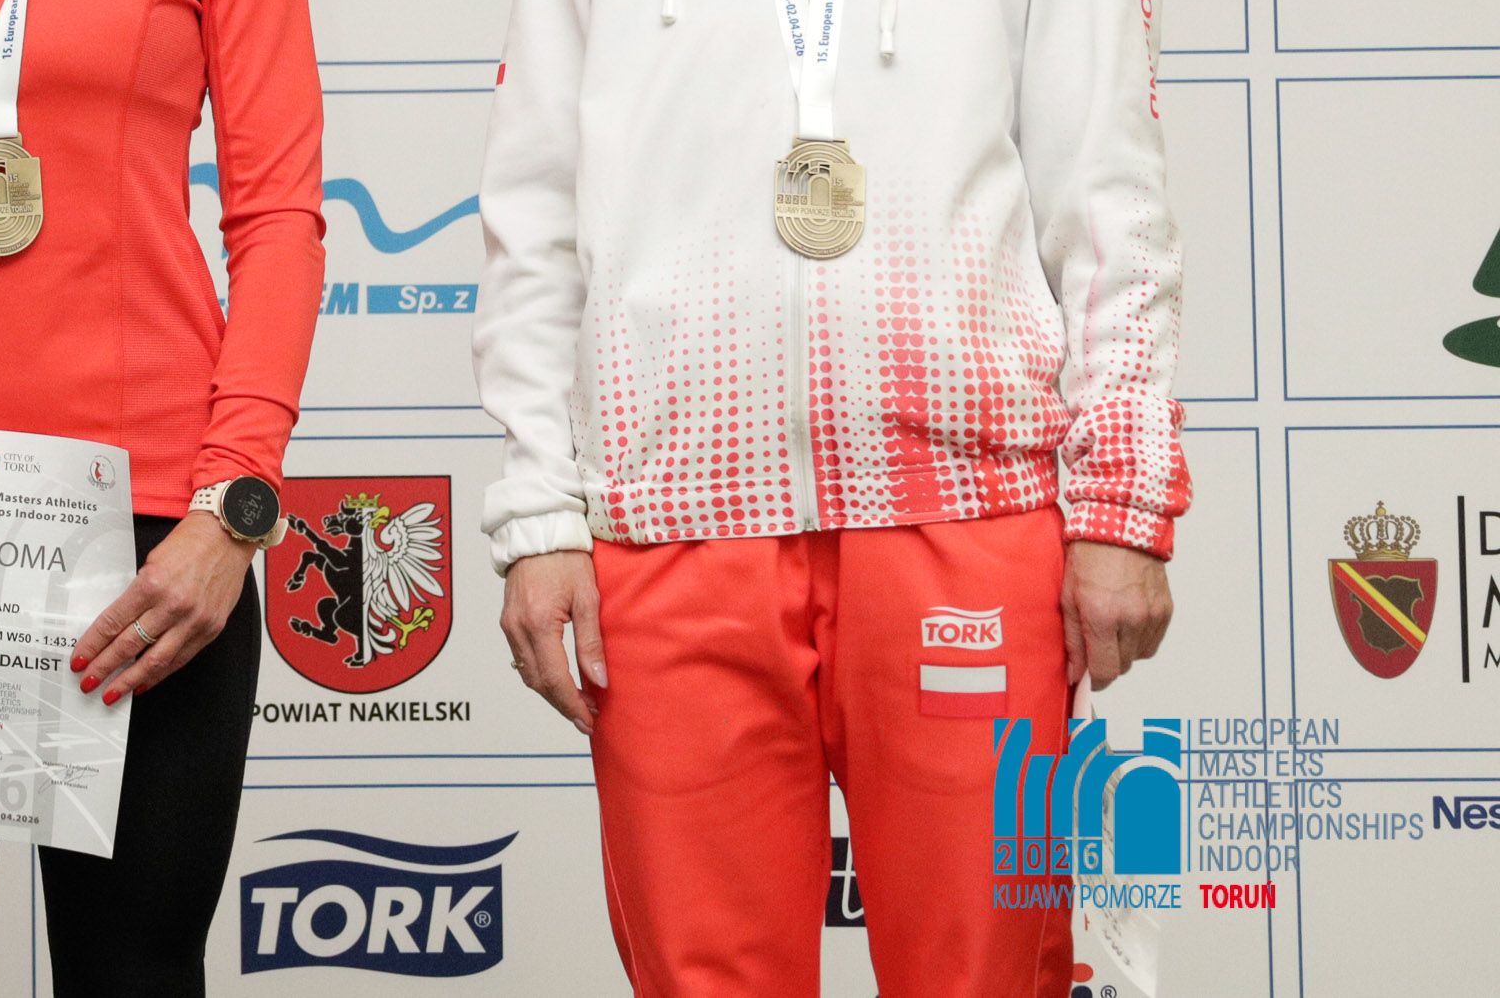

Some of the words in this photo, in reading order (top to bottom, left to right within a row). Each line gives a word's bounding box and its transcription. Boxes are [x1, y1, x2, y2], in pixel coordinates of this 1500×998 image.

[819, 1, 833, 45] European
[398, 286, 443, 313] Sp.
[453, 290, 470, 309] z
[3, 452, 24, 462] CITY
[25, 454, 36, 463] OF
[3, 460, 41, 474] TORUŃ
[45, 496, 98, 512] Athletics
[15, 508, 57, 521] Indoor
[60, 513, 89, 525] 2026
[7, 631, 32, 644] W50
[924, 622, 998, 644] TORK
[350, 702, 469, 721] NAKIELSKI
[250, 883, 495, 959] TORK
